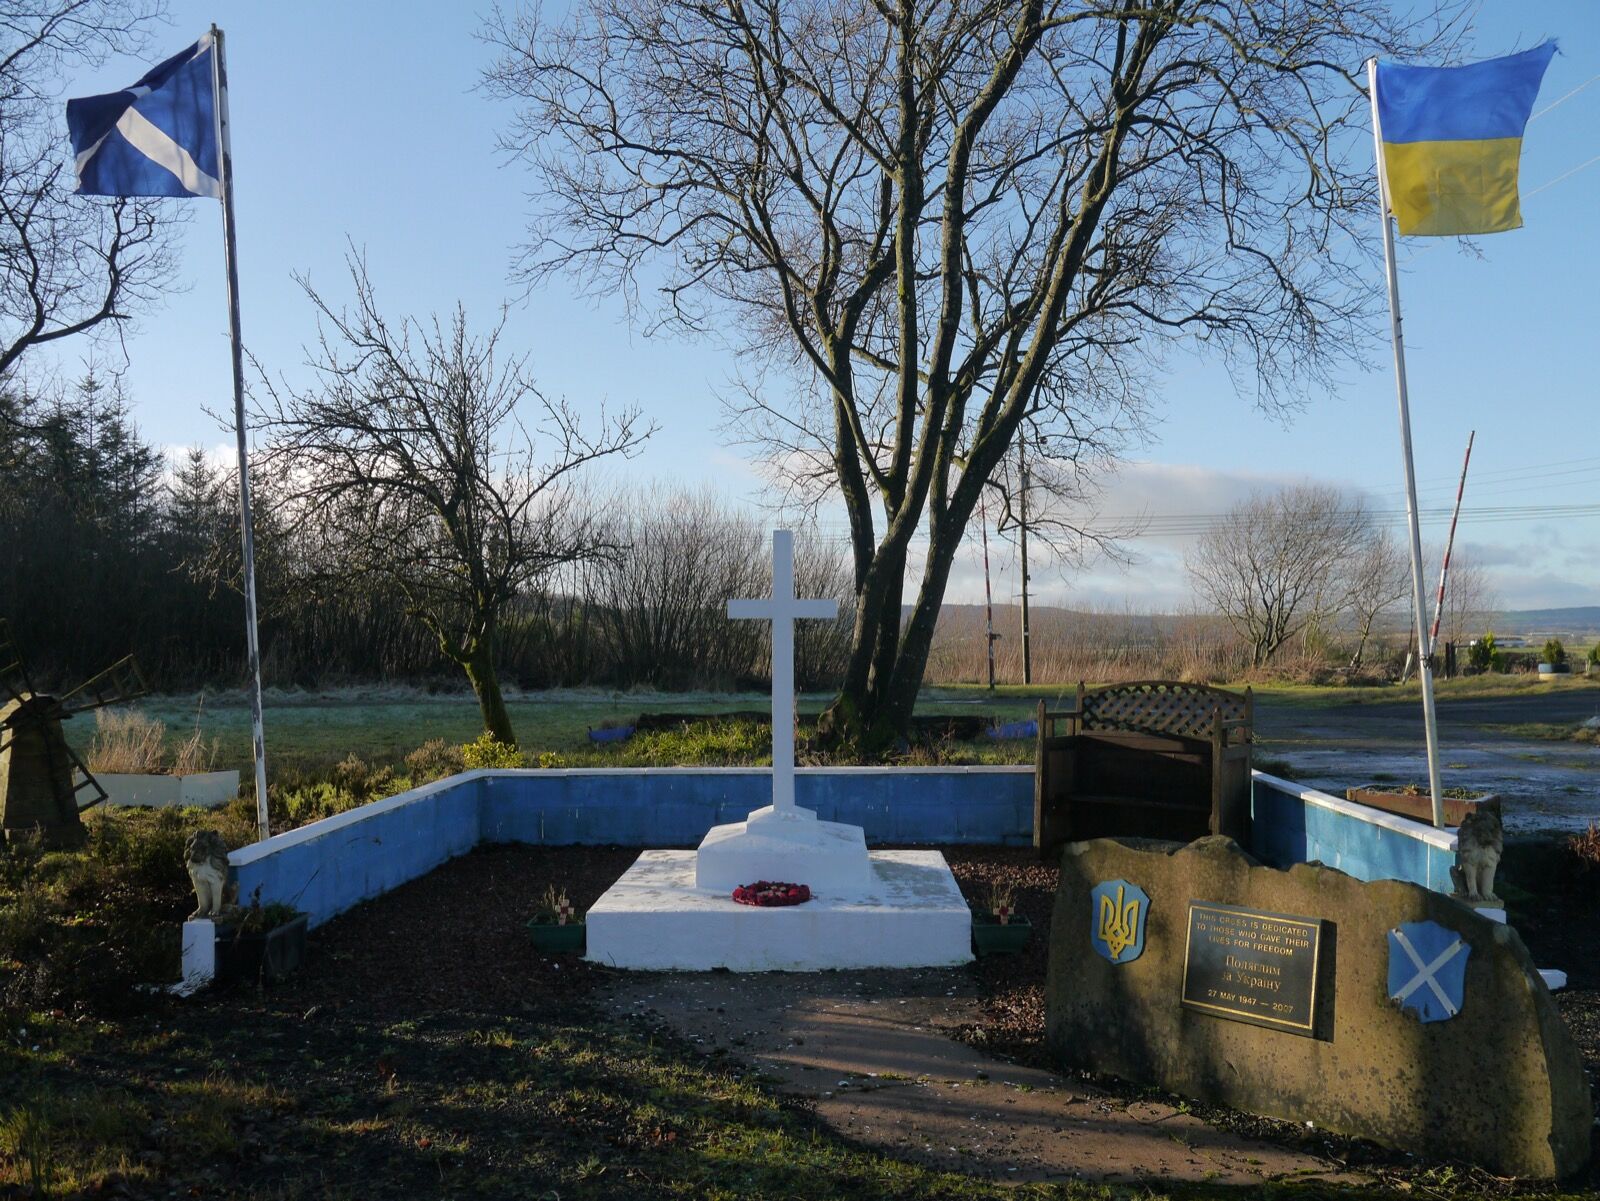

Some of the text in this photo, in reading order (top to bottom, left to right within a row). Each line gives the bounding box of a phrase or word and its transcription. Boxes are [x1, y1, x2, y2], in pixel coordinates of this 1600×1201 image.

[1196, 922, 1309, 949] TO THOSE WHO GAVE THEIR
[1250, 921, 1259, 930] IS
[1262, 922, 1308, 937] DEDICATED
[1233, 939, 1250, 949] FOR
[1253, 942, 1293, 956] FREEDOM
[1207, 988, 1217, 998] 27
[1219, 991, 1236, 1002] MAY
[1239, 994, 1257, 1006] 1947
